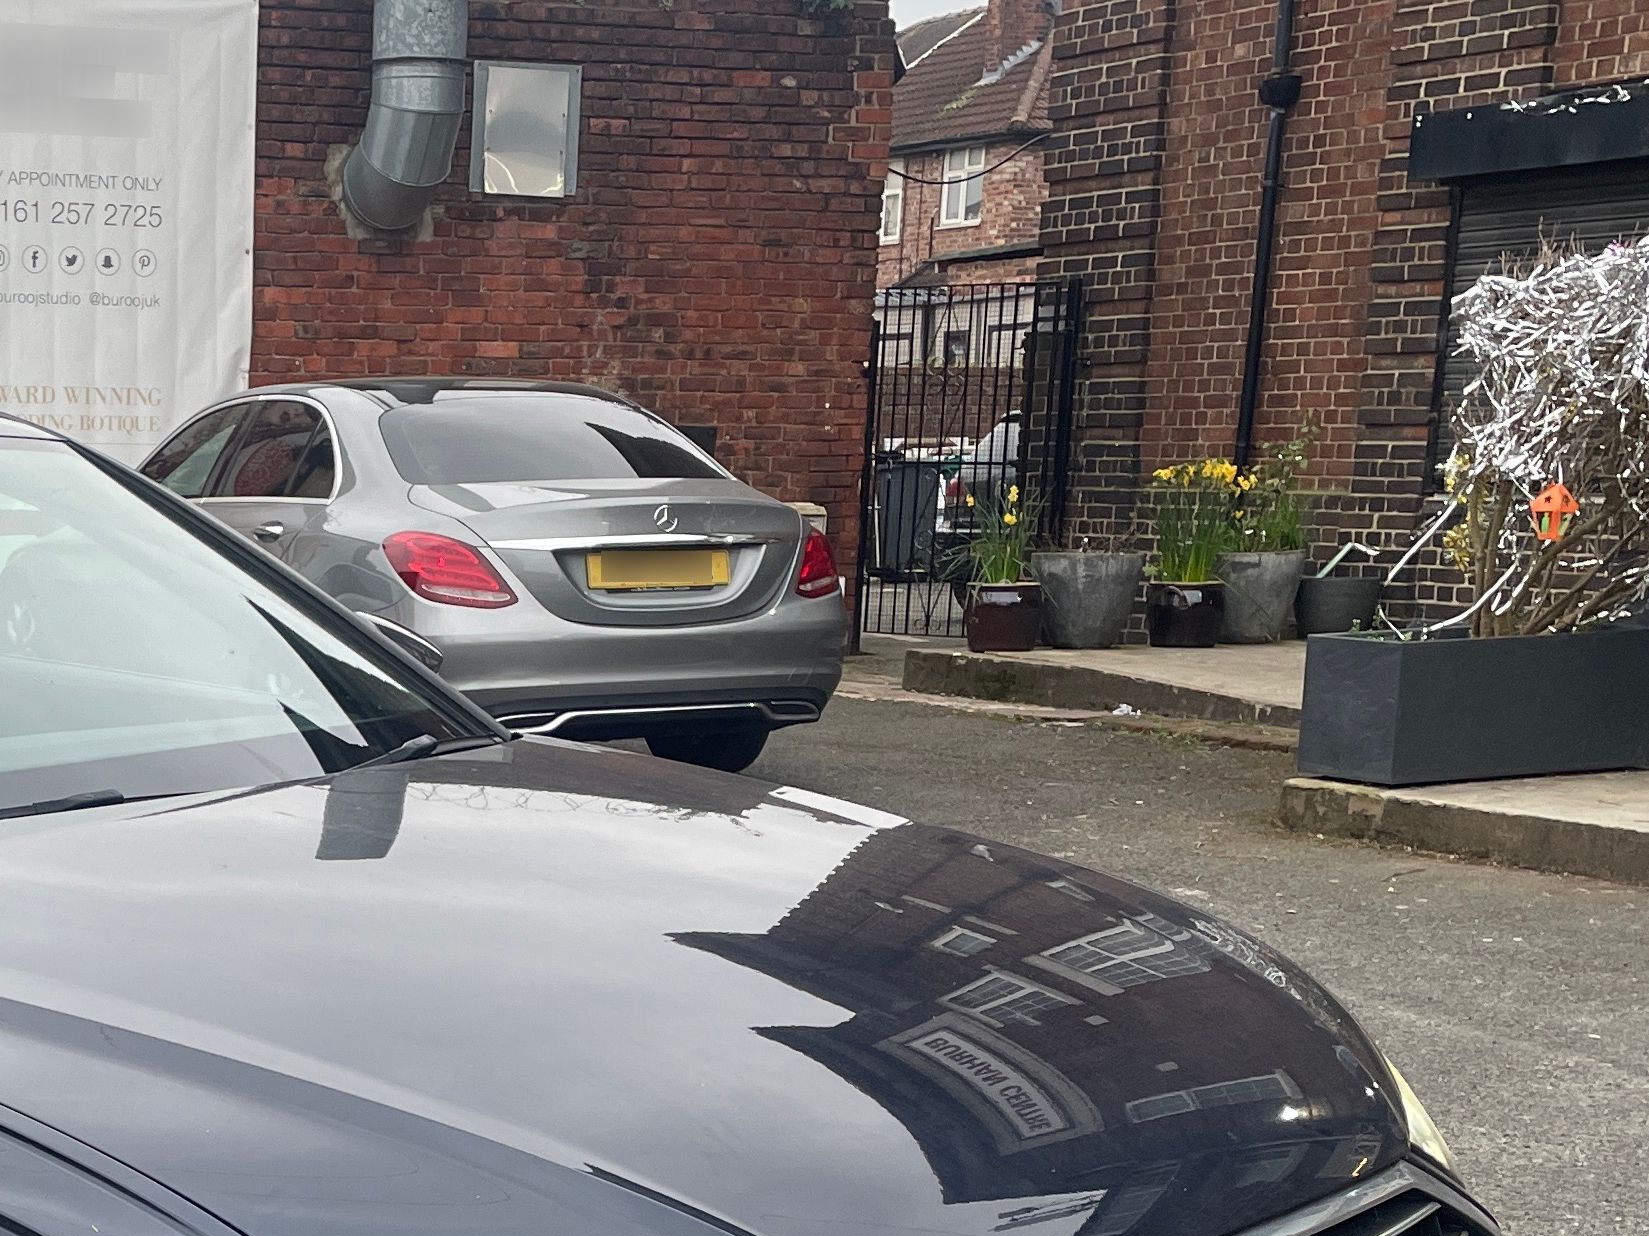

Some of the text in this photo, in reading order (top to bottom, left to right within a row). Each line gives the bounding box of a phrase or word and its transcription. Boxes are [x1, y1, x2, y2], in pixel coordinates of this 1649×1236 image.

[8, 171, 118, 189] APPOINTMENT
[122, 175, 162, 191] ONLY
[51, 201, 95, 225] 257
[104, 203, 163, 228] 2725
[88, 291, 160, 311] @buroojuk
[63, 386, 161, 406] WINNING
[79, 414, 161, 436] BOTIQUE
